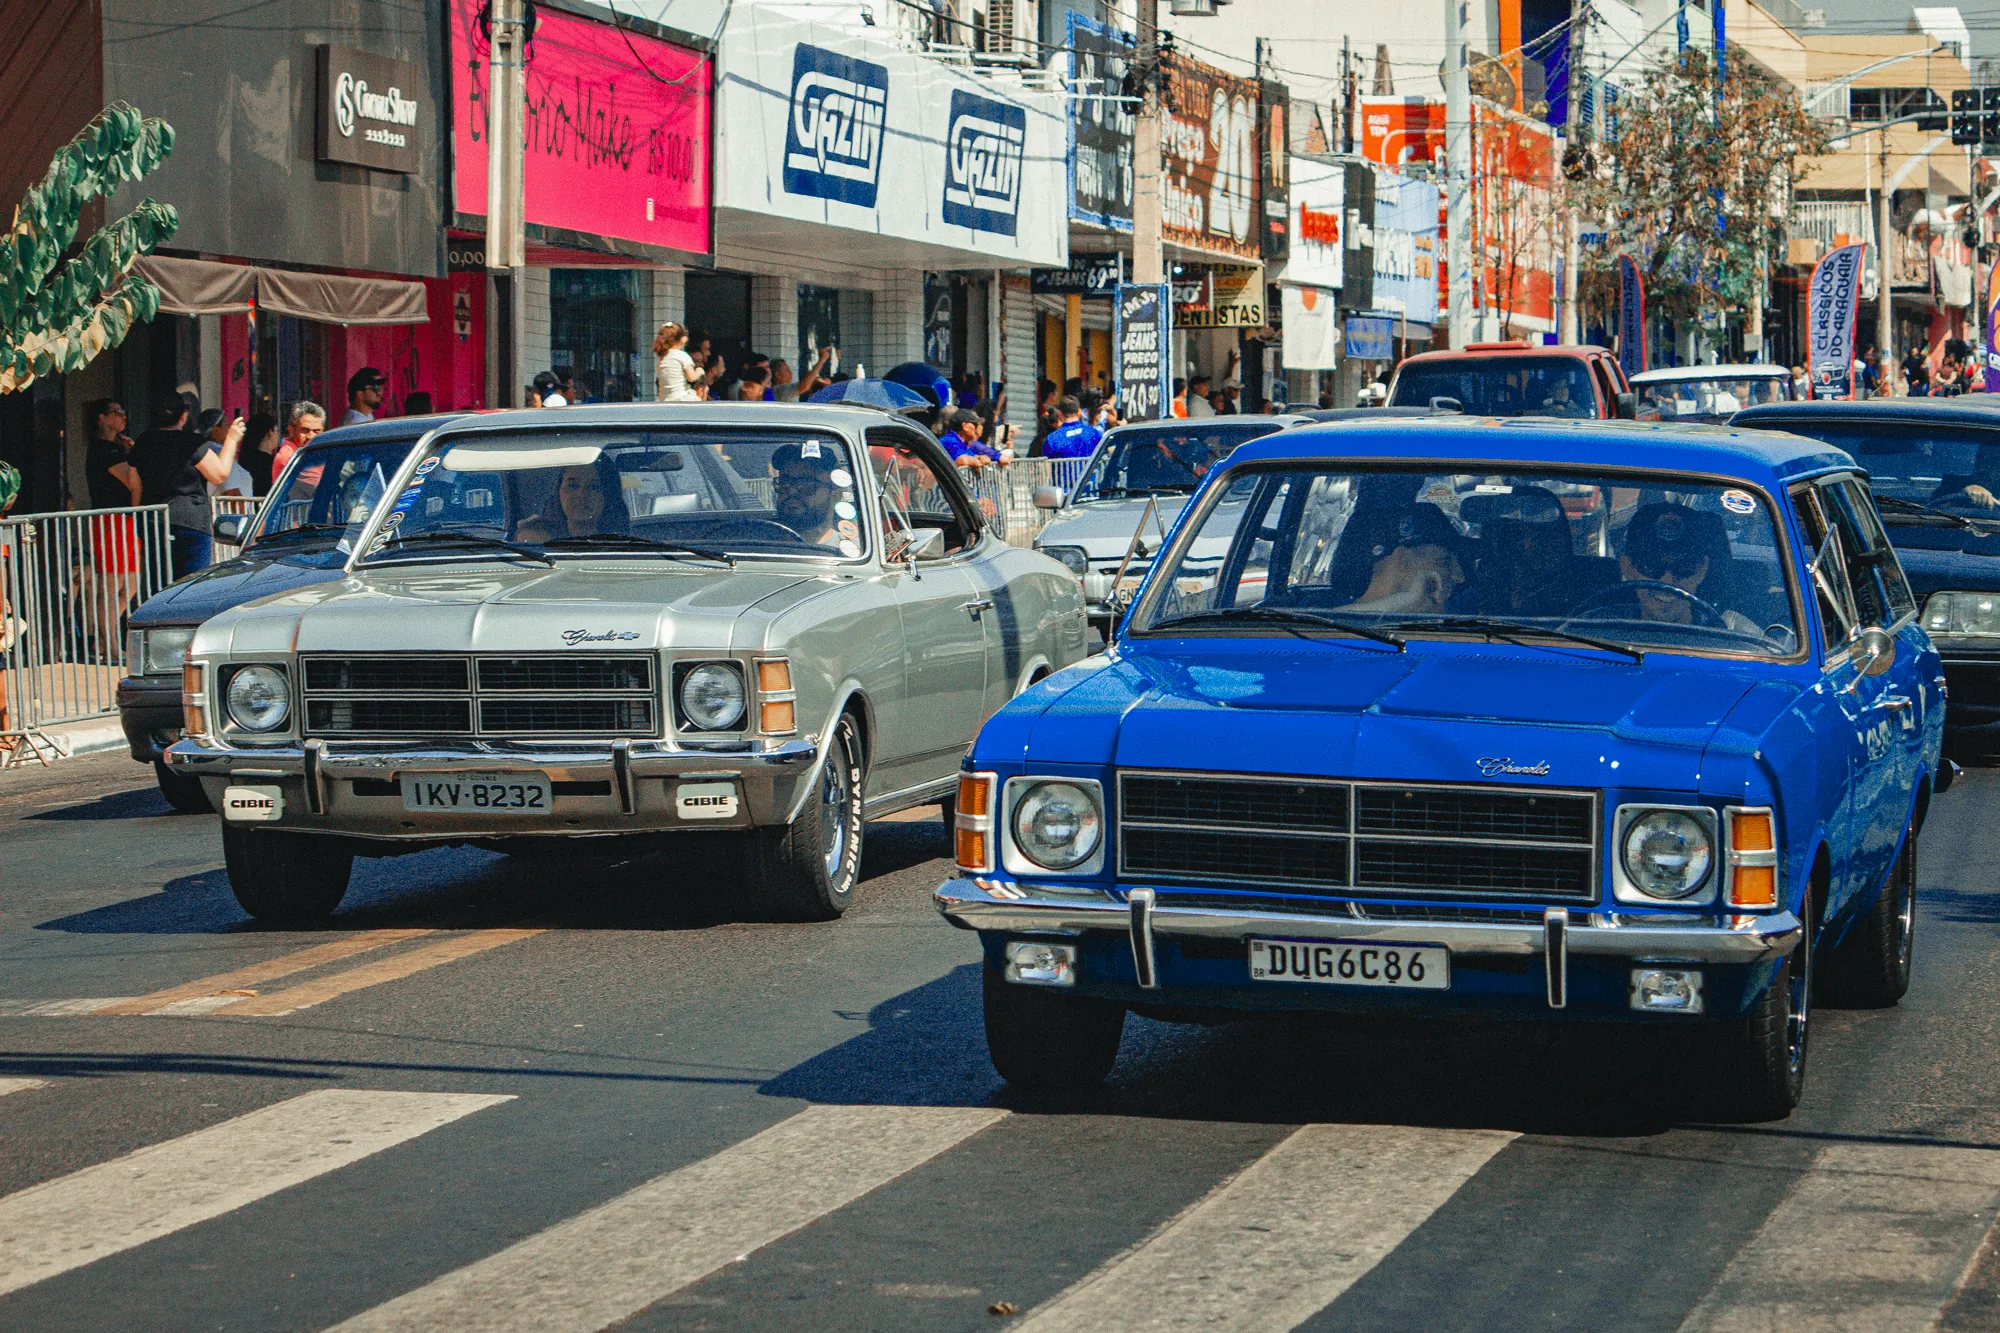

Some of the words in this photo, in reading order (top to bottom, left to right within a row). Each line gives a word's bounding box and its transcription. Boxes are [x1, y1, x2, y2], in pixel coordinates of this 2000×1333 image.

[787, 71, 885, 185] GAZIN
[945, 114, 1024, 214] GAZIN
[1122, 331, 1158, 351] JEANS
[1123, 352, 1158, 366] PREÇO
[1124, 364, 1158, 380] ÚNICO
[231, 800, 274, 808] CIBIE
[683, 796, 728, 806] CIBIE
[846, 767, 861, 874] DYNAMIC
[1253, 967, 1265, 978] BR
[1268, 944, 1425, 983] DUG6C86
